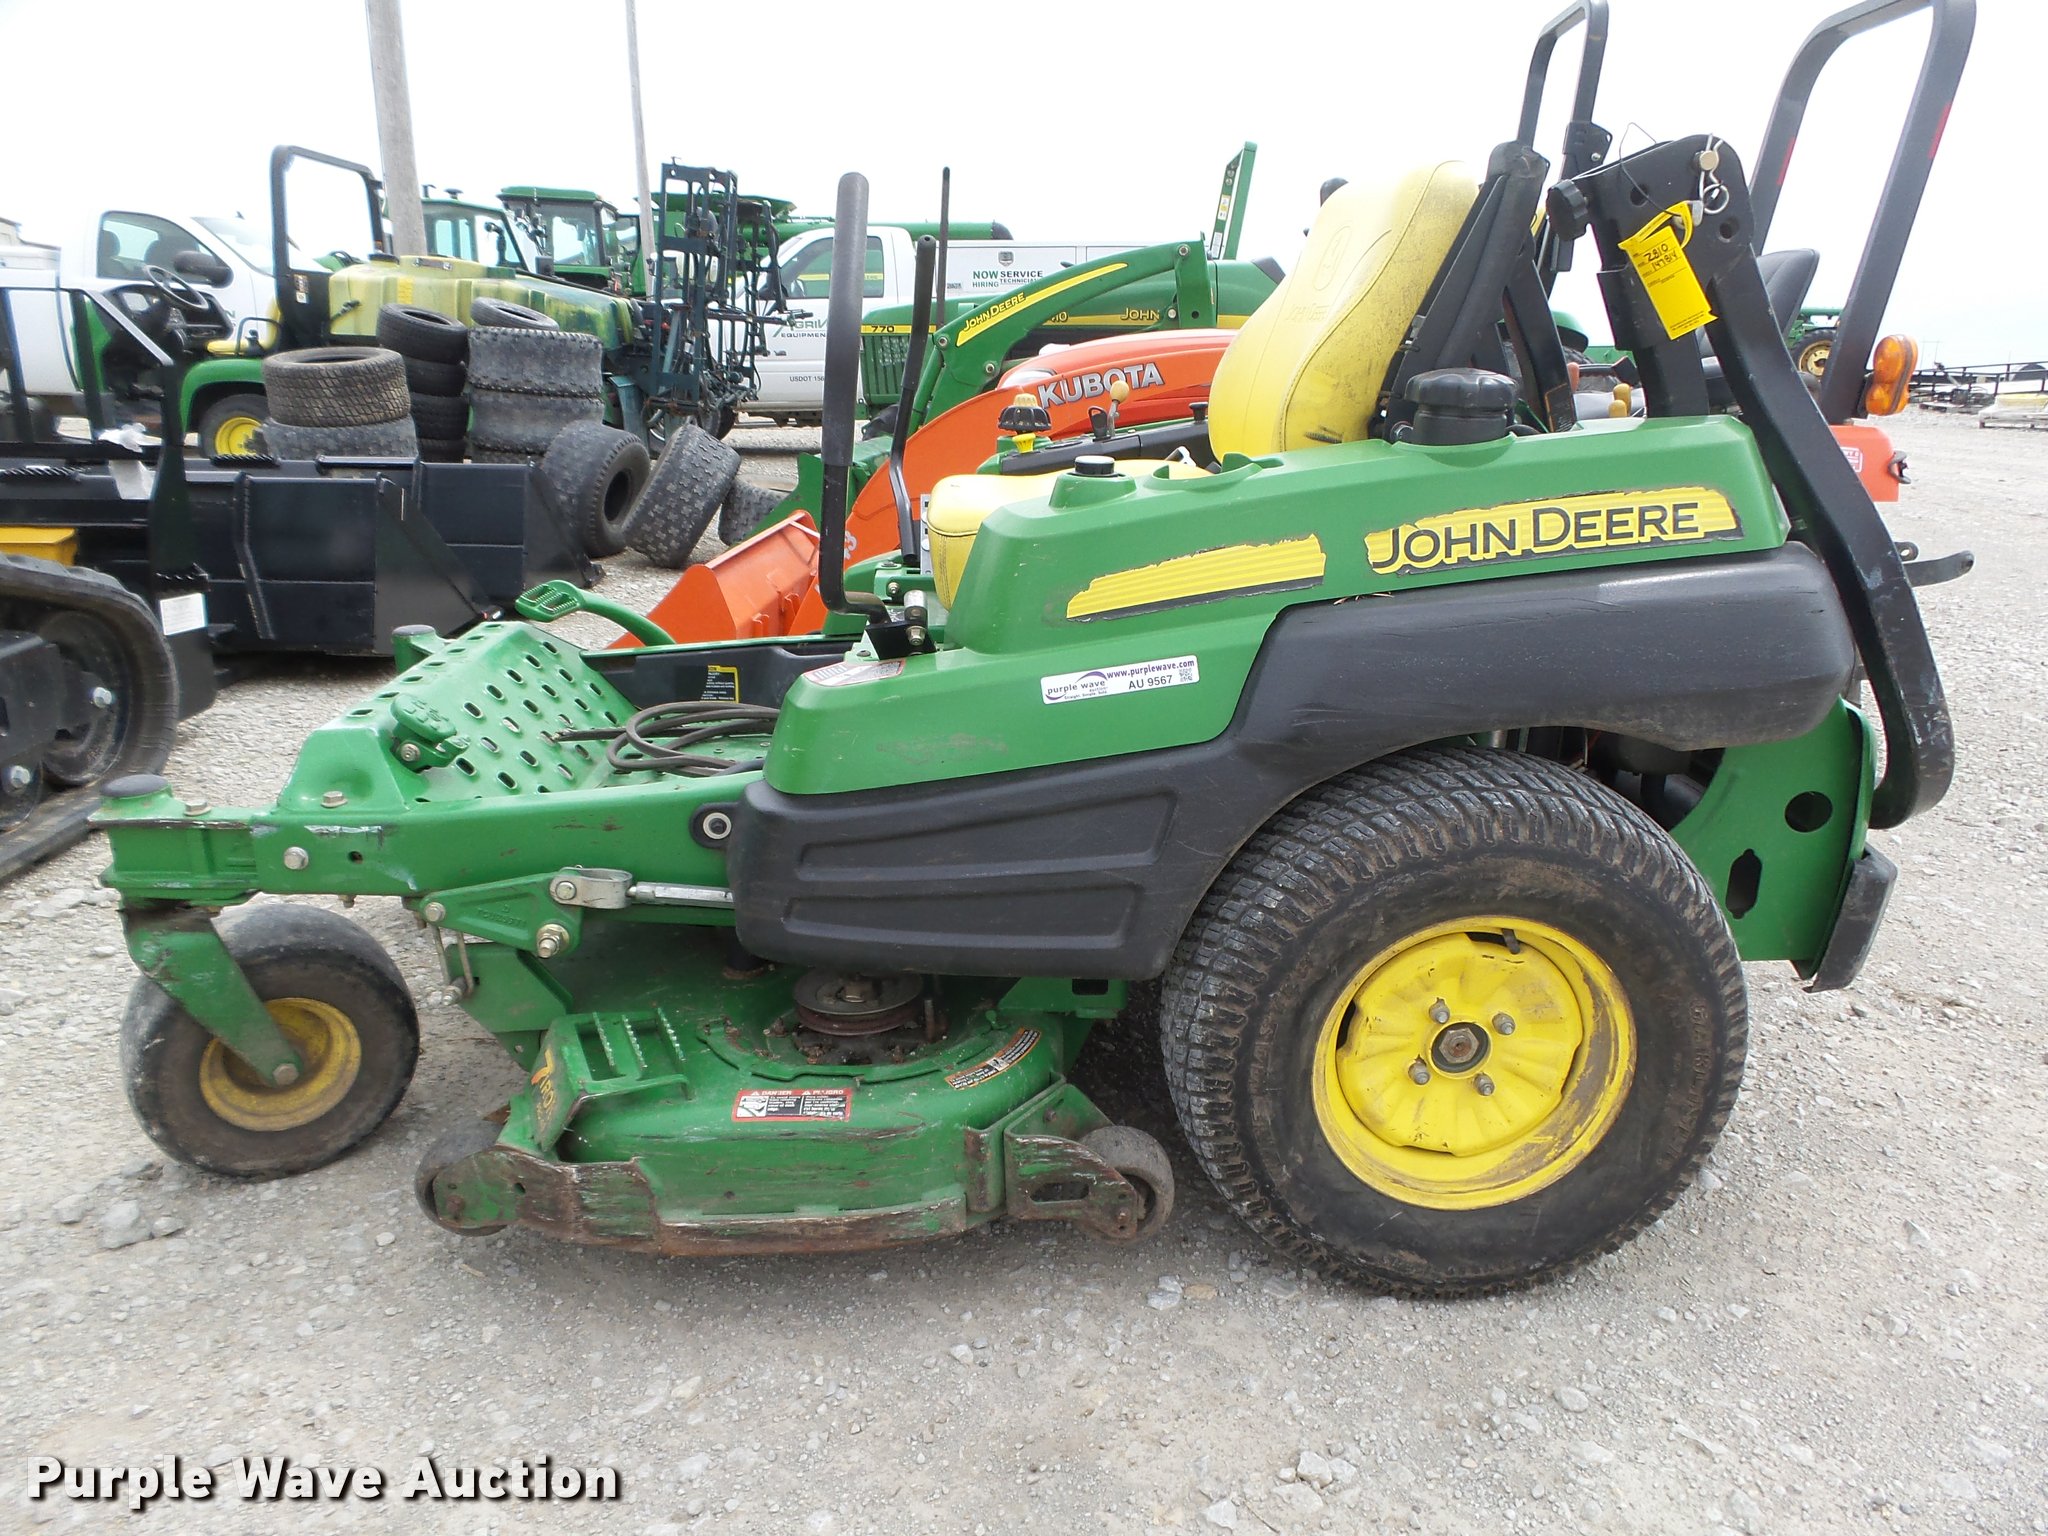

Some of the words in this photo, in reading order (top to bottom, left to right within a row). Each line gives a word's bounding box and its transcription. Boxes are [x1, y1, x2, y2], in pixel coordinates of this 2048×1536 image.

[972, 270, 999, 279] NOW
[1000, 270, 1043, 278] SERVICE
[963, 310, 991, 331] JOHN
[990, 291, 1026, 317] DEERE
[1120, 307, 1160, 321] JOHN
[871, 325, 895, 333] 770
[1037, 362, 1166, 410] KUBOTA
[1372, 518, 1517, 569] JOHN
[1532, 502, 1699, 548] DEERE
[1106, 659, 1195, 679] www.purplewave.com
[1047, 683, 1078, 696] purple
[1080, 680, 1106, 689] wave
[1128, 678, 1144, 690] AU
[1147, 674, 1173, 687] 9567
